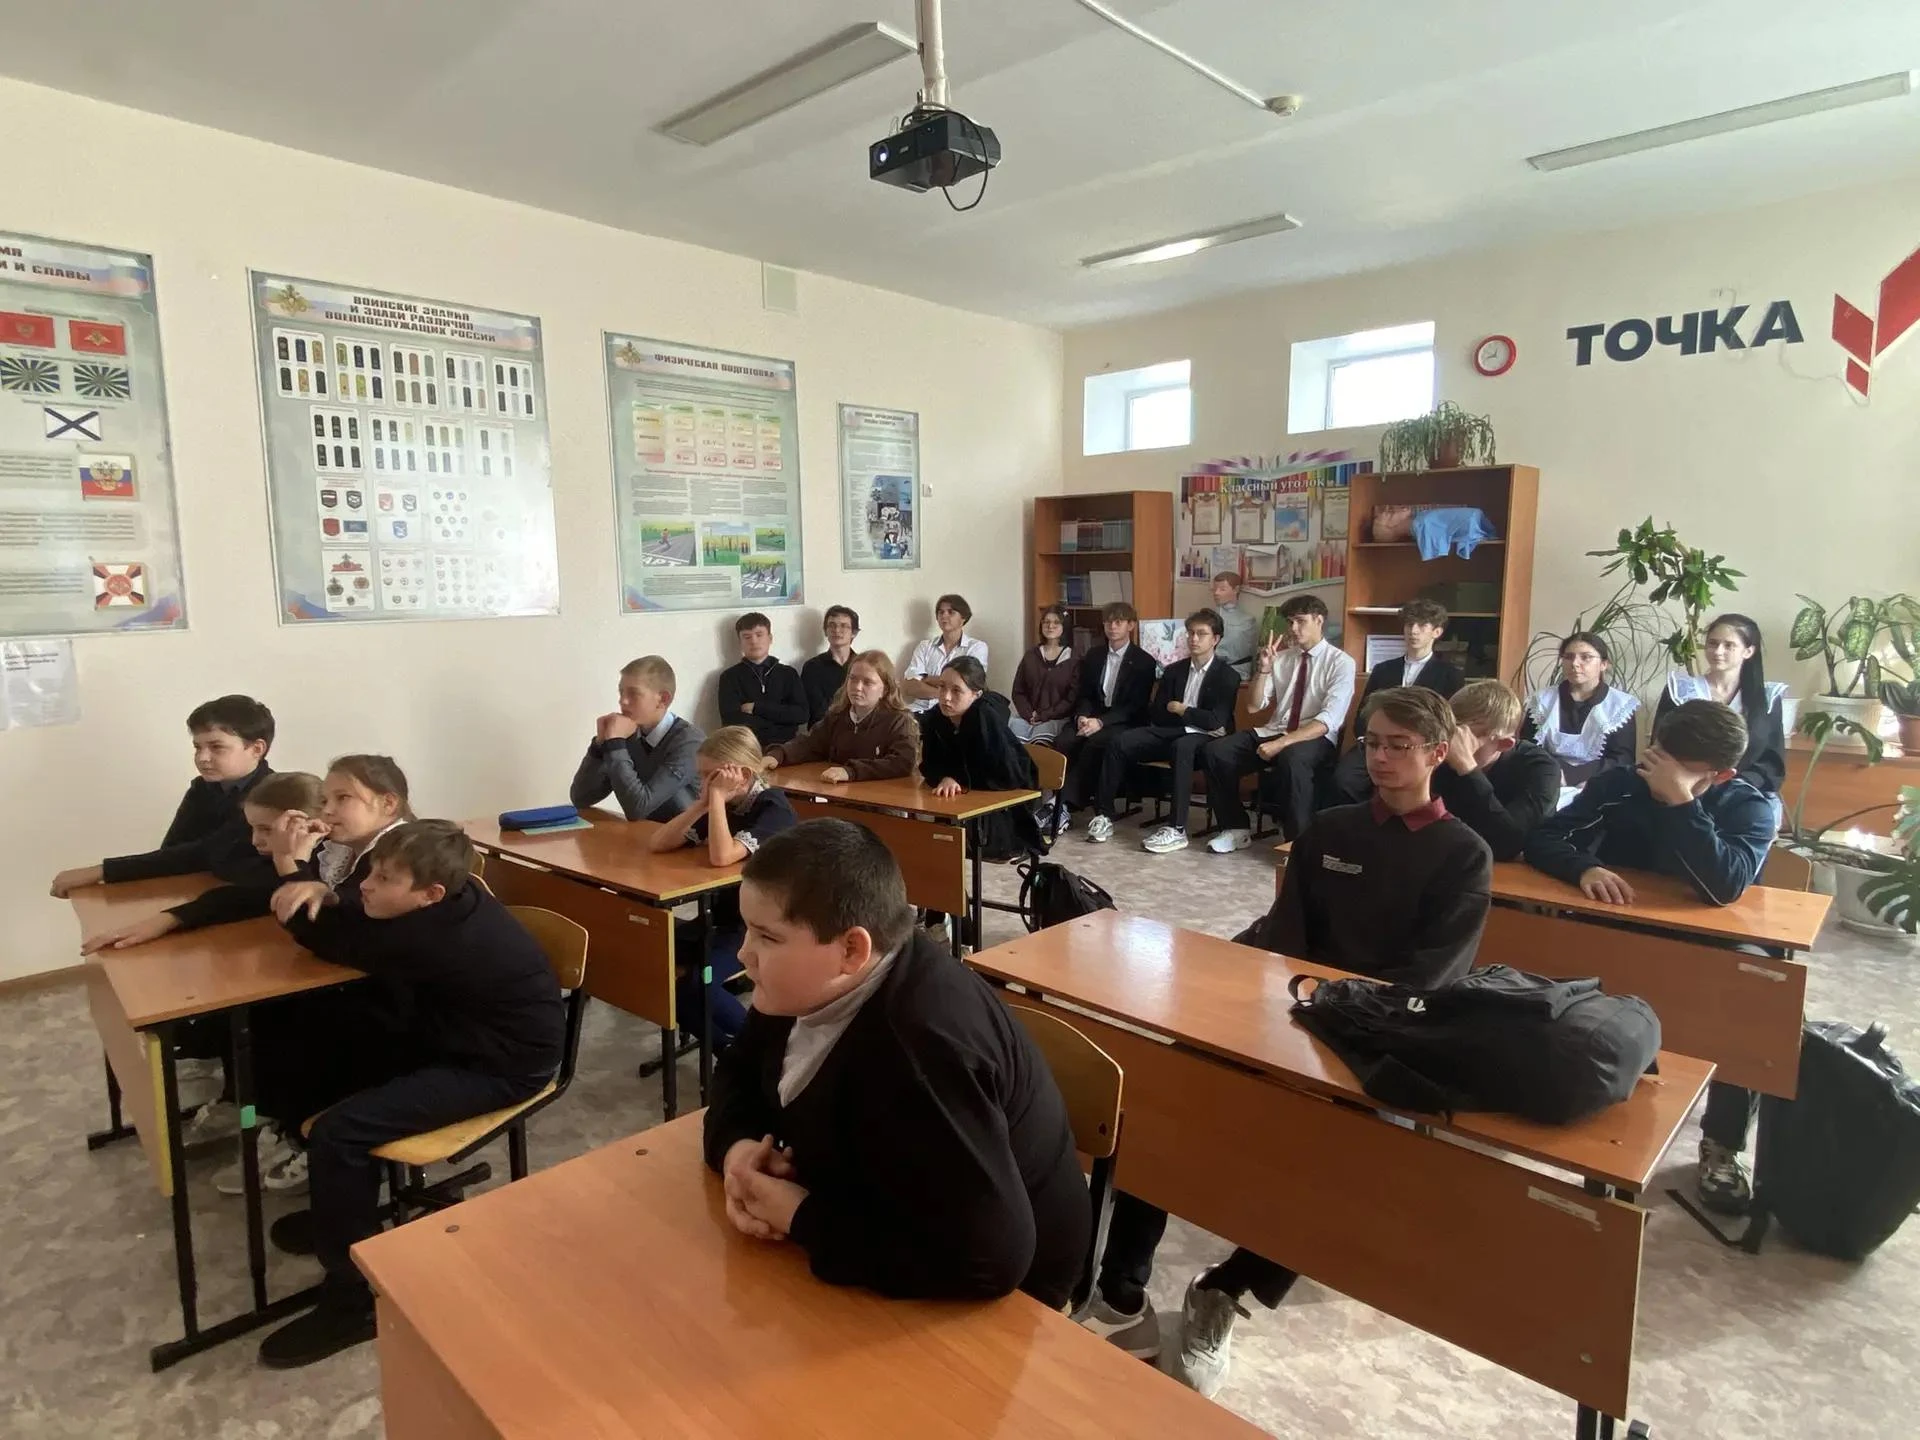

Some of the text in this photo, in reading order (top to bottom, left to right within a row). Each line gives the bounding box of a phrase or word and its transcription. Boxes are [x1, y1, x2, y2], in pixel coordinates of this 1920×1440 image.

[14, 262, 25, 272] И
[32, 265, 91, 281] СЛАВЫ
[350, 305, 474, 331] И ЗНАКИ РАЗЛИЧИЯ
[353, 295, 470, 321] ВОИНСКИЕ ЗВАНИЯ
[325, 311, 496, 343] ВОЕННОСЛУЖАЩИХ РОССИИ
[1567, 300, 1804, 366] ТОЧКА
[654, 353, 775, 377] ФИЗИЧЕСКАЯ ПОДГОТОВКА
[1280, 478, 1324, 492] уголок
